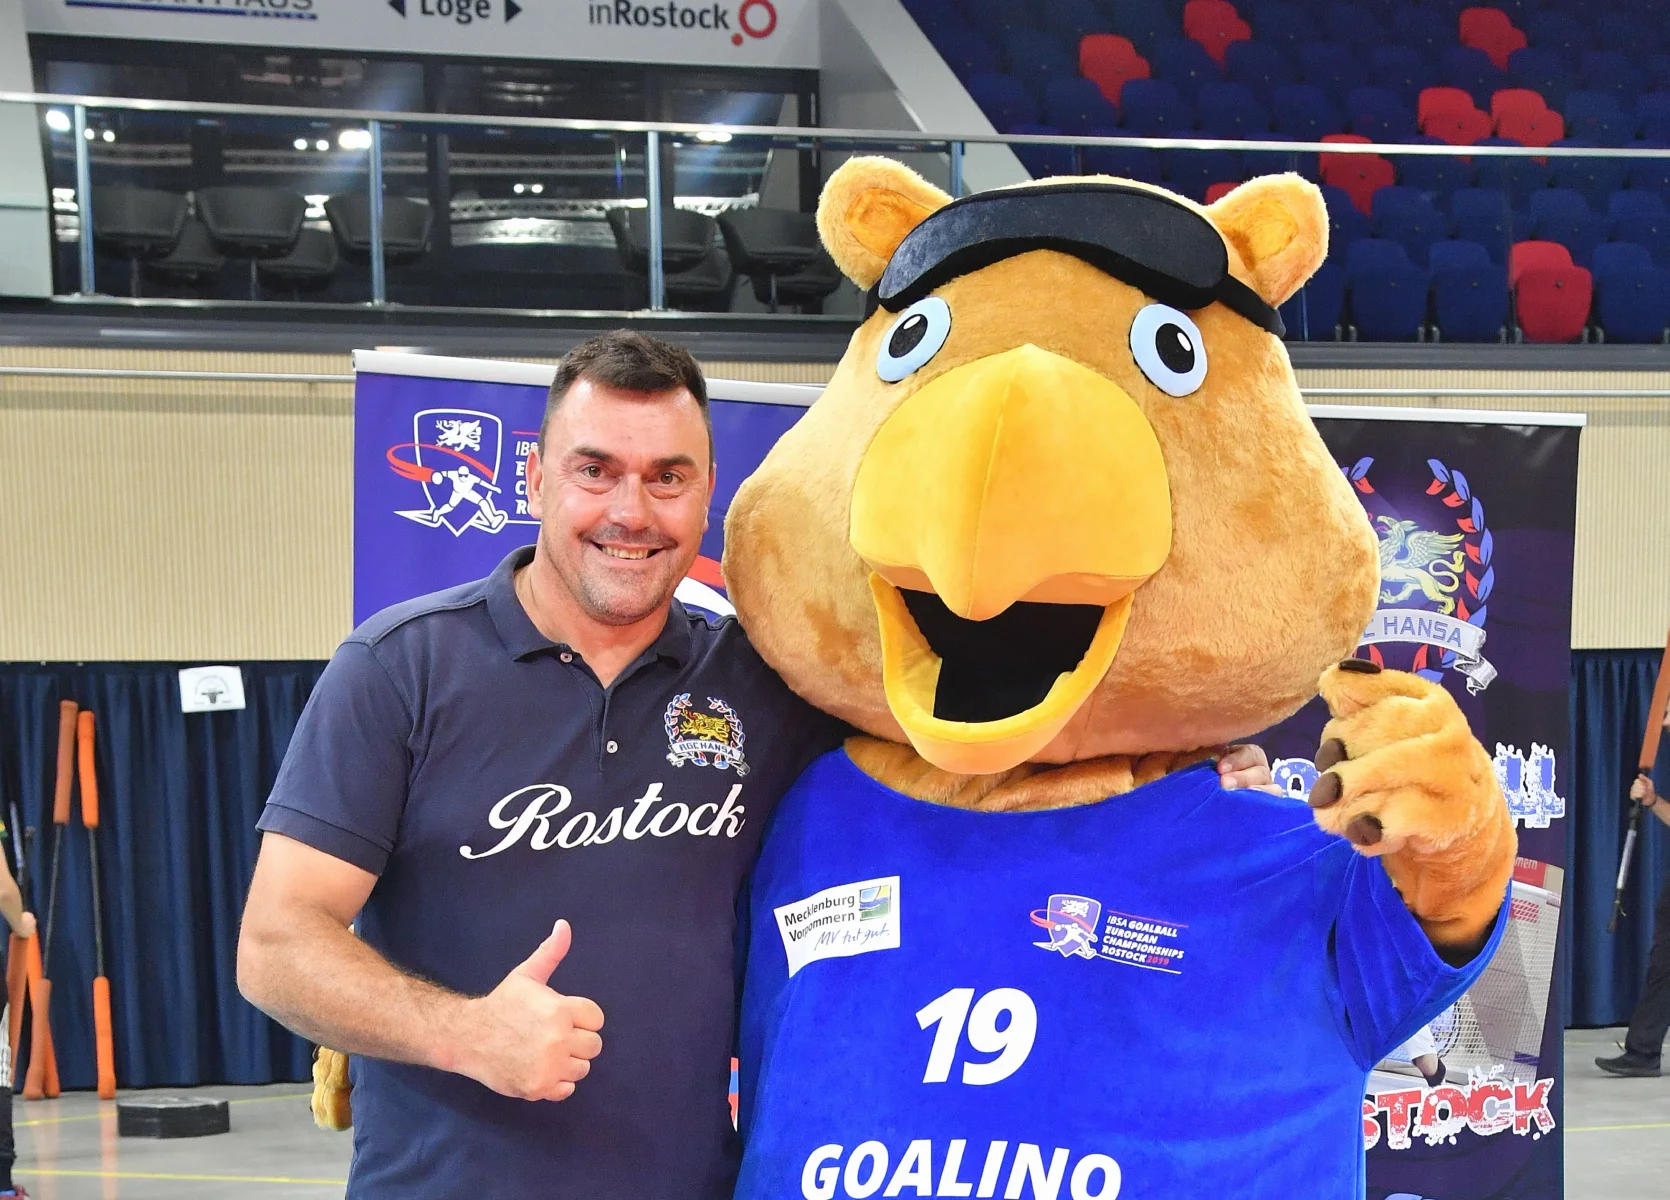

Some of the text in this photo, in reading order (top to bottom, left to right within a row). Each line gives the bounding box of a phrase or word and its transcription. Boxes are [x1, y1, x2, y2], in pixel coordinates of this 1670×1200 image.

[421, 0, 491, 24] Loge
[589, 0, 731, 30] inRostock
[1383, 616, 1462, 648] HANSA
[459, 782, 747, 860] Rostock
[784, 895, 855, 927] Mecklenburg
[788, 912, 855, 942] Vorpommern
[1105, 925, 1158, 944] EUROPEAN
[1107, 915, 1178, 938] IBSA GOALBALL
[814, 930, 841, 952] MV
[1101, 944, 1147, 963] ROSTOCK
[1103, 935, 1185, 959] CHAMPIONSHIPS
[915, 987, 1037, 1086] 19
